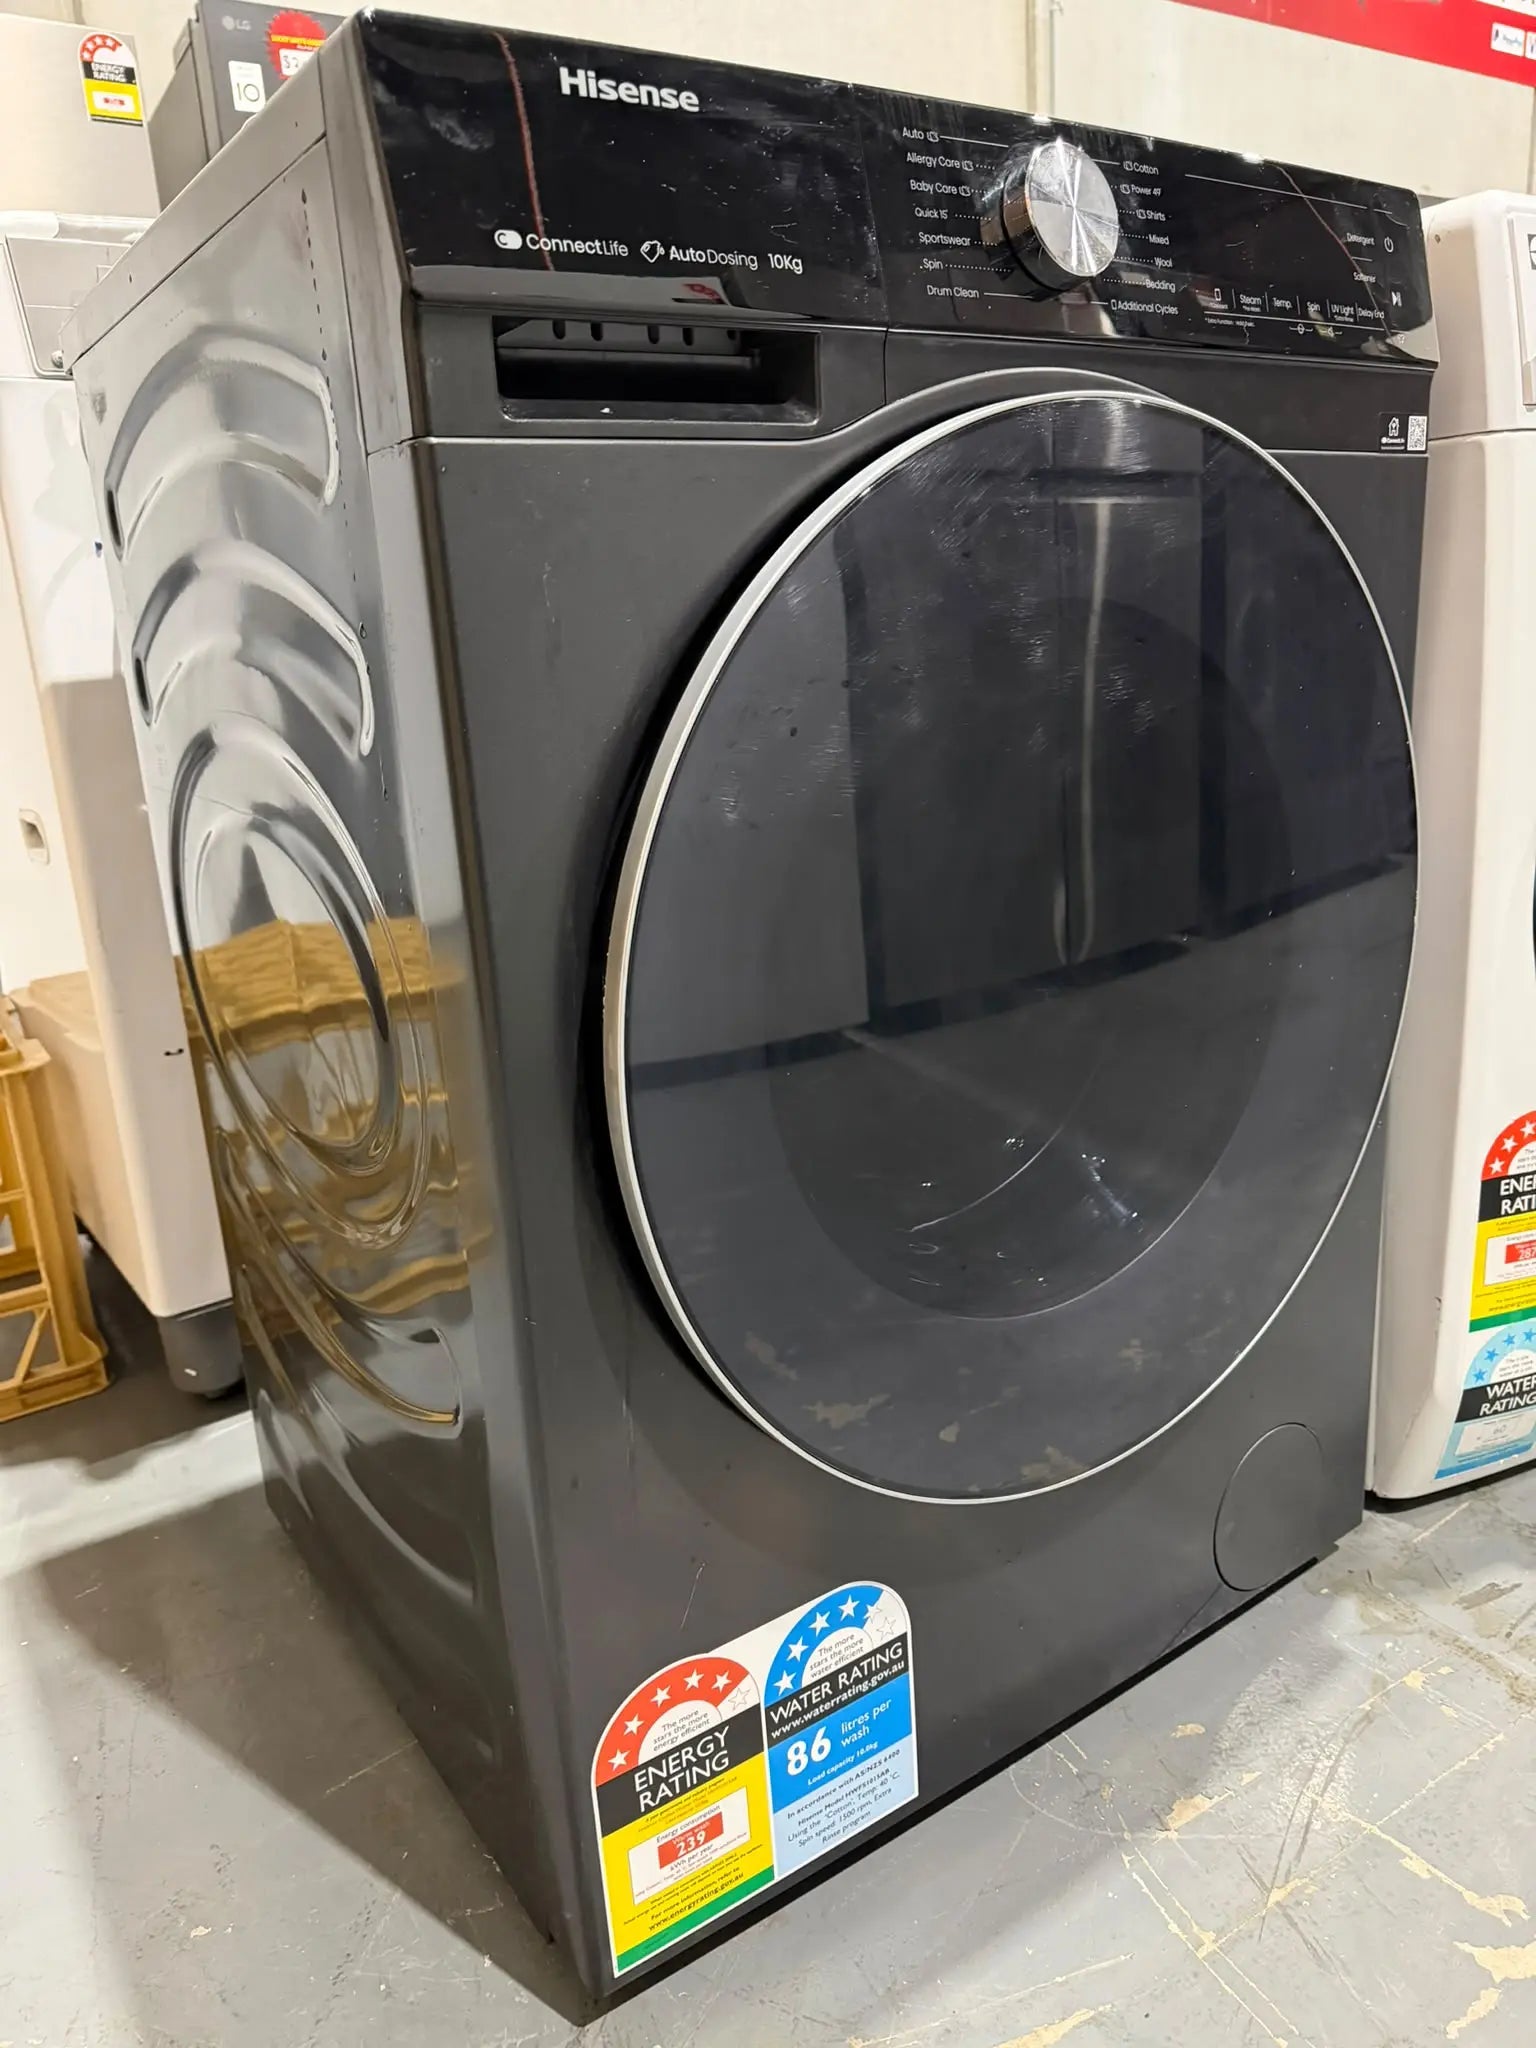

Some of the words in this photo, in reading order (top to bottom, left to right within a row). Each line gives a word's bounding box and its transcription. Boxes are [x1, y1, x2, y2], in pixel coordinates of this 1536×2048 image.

[236, 19, 251, 31] LG
[237, 82, 260, 102] 10
[559, 66, 700, 112] Hisense
[902, 126, 924, 140] Auto
[906, 152, 937, 168] Allergy
[938, 156, 960, 168] Care
[1133, 162, 1159, 175] Cotton
[910, 179, 934, 194] Baby
[935, 183, 957, 194] Care
[1131, 184, 1151, 195] Power
[914, 207, 939, 218] Quick
[1146, 210, 1166, 221] Shirts
[526, 233, 629, 257] ConnectLife
[918, 231, 971, 246] Sportswear
[1148, 234, 1169, 245] Mixed
[1346, 232, 1375, 246] Detergent
[670, 247, 758, 271] AutoDosing
[768, 253, 803, 274] 10Kg
[922, 258, 943, 271] Spin
[1154, 257, 1172, 268] Wool
[926, 285, 952, 296] Drum
[953, 287, 979, 298] Clean
[1145, 279, 1176, 293] Bedding
[1118, 300, 1154, 312] Additional
[1155, 303, 1178, 315] Cycles
[1240, 294, 1261, 305] Steam
[1306, 301, 1320, 313] Spin
[1331, 304, 1340, 313] UV
[1340, 305, 1354, 316] Light
[1358, 307, 1373, 320] Delay
[1374, 309, 1384, 319] End
[1500, 1174, 1536, 1196] ENE
[1480, 1391, 1536, 1416] RATING
[810, 1658, 828, 1671] stars
[830, 1649, 842, 1660] the
[844, 1637, 864, 1653] more
[818, 1646, 833, 1657] The
[834, 1634, 855, 1649] more
[810, 1664, 833, 1679] water
[834, 1646, 864, 1667] efficient
[770, 1682, 833, 1724] WATER
[838, 1642, 903, 1689] RATING
[771, 1660, 905, 1739] www.waterrating.gov.au
[653, 1732, 671, 1743] stars
[673, 1723, 686, 1733] the
[688, 1712, 708, 1727] more
[662, 1721, 677, 1732] The
[678, 1710, 699, 1725] more
[841, 1712, 869, 1734] litres
[872, 1699, 892, 1720] per
[653, 1736, 679, 1752] energy
[681, 1718, 710, 1737] efficient
[840, 1725, 870, 1747] wash
[634, 1725, 729, 1792] ENERGY
[787, 1726, 832, 1776] 86
[807, 1770, 825, 1785] Load
[826, 1754, 855, 1775] capacity
[856, 1742, 878, 1758] 10.0kg
[639, 1750, 729, 1813] RATING
[787, 1810, 795, 1819] In
[796, 1787, 837, 1814] accordance
[838, 1777, 854, 1789] with
[788, 1826, 808, 1842] Using
[809, 1819, 821, 1829] the
[879, 1778, 888, 1787] 40
[798, 1806, 823, 1826] Hisense
[824, 1797, 844, 1811] Model
[798, 1835, 814, 1848] Spin
[839, 1809, 856, 1822] 1500
[874, 1788, 892, 1801] Extra
[656, 1828, 679, 1843] Energy
[680, 1804, 720, 1830] consumption
[822, 1830, 840, 1844] Rinse
[842, 1811, 871, 1833] program
[676, 1830, 706, 1858] 239
[670, 1860, 687, 1871] kWh
[687, 1852, 699, 1864] per
[700, 1843, 713, 1856] year
[649, 1872, 744, 1930] www.energyrating.gov.au
[651, 1911, 662, 1920] For
[663, 1902, 679, 1913] more
[717, 1871, 732, 1881] refer
